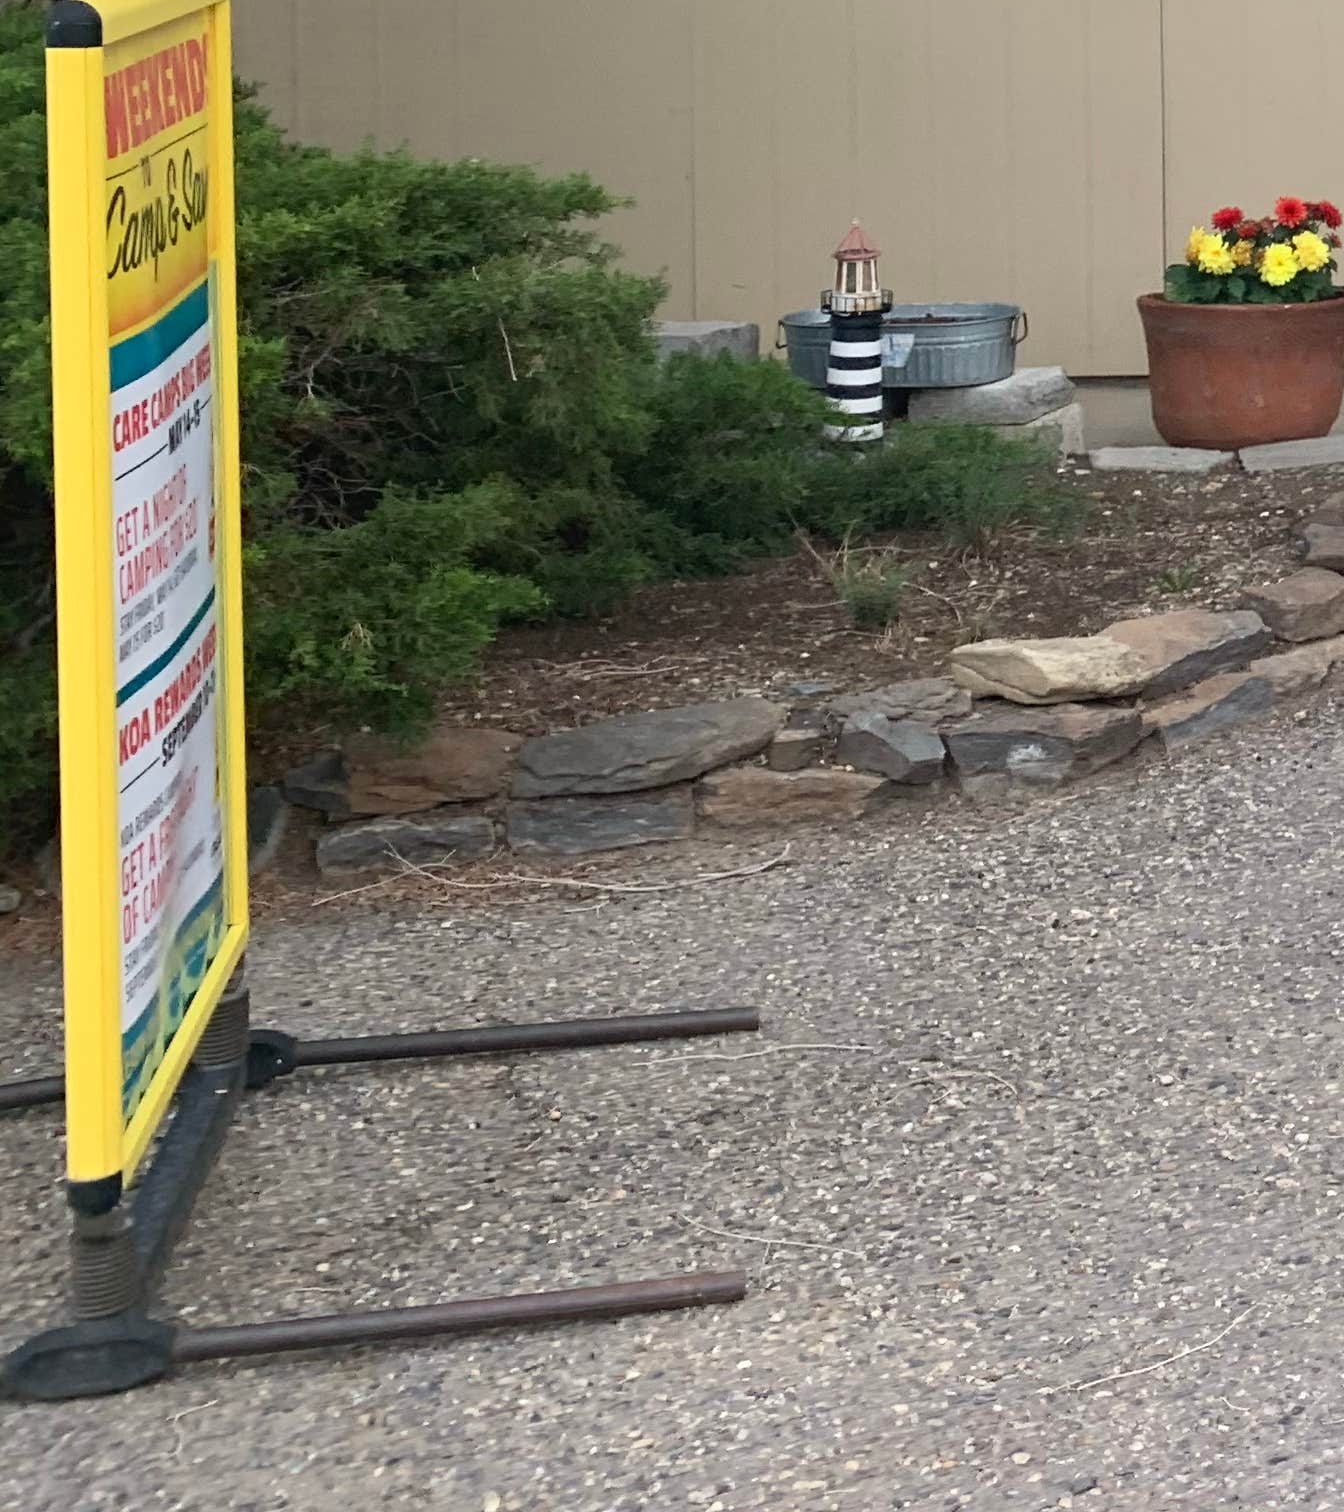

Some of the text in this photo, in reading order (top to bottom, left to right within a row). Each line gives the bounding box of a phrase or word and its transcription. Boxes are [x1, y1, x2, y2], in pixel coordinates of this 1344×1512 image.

[106, 185, 167, 283] Camp
[113, 399, 149, 452] CARE
[151, 371, 181, 429] CAMPS
[116, 500, 151, 557] GET A
[119, 707, 151, 767] KOA
[154, 647, 202, 736] REWARDS
[121, 841, 144, 897] GET
[149, 833, 157, 871] A
[123, 895, 139, 945] OF
